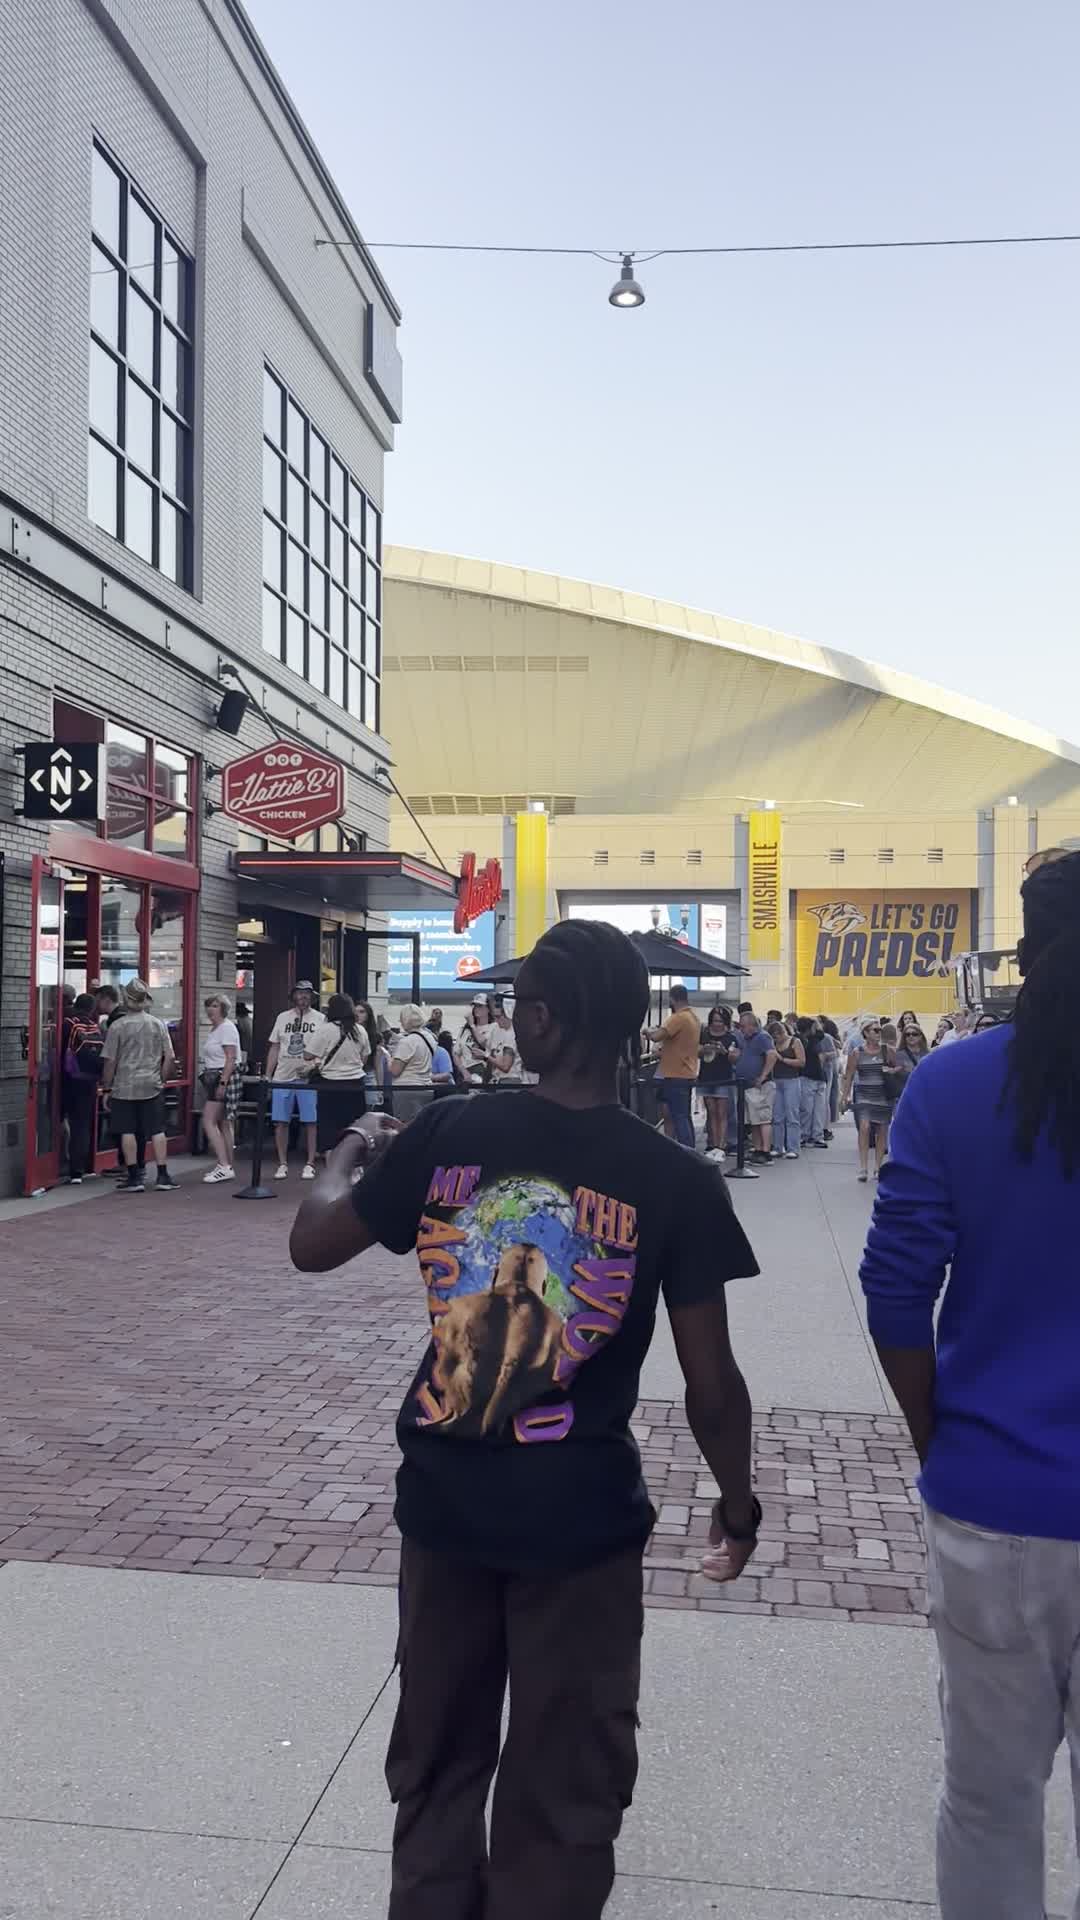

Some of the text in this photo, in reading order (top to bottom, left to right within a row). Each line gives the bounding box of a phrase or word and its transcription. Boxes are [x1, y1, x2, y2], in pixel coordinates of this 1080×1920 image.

[265, 754, 302, 765] HOT
[51, 766, 72, 795] N
[229, 768, 337, 810] Hattie B's
[259, 811, 307, 819] CHICKEN
[752, 842, 778, 930] SMASHVILLE
[870, 903, 960, 930] LET'S GO
[432, 943, 482, 954] responders
[813, 932, 955, 978] PREDS!
[426, 1166, 481, 1207] ME
[572, 1186, 639, 1251] THE
